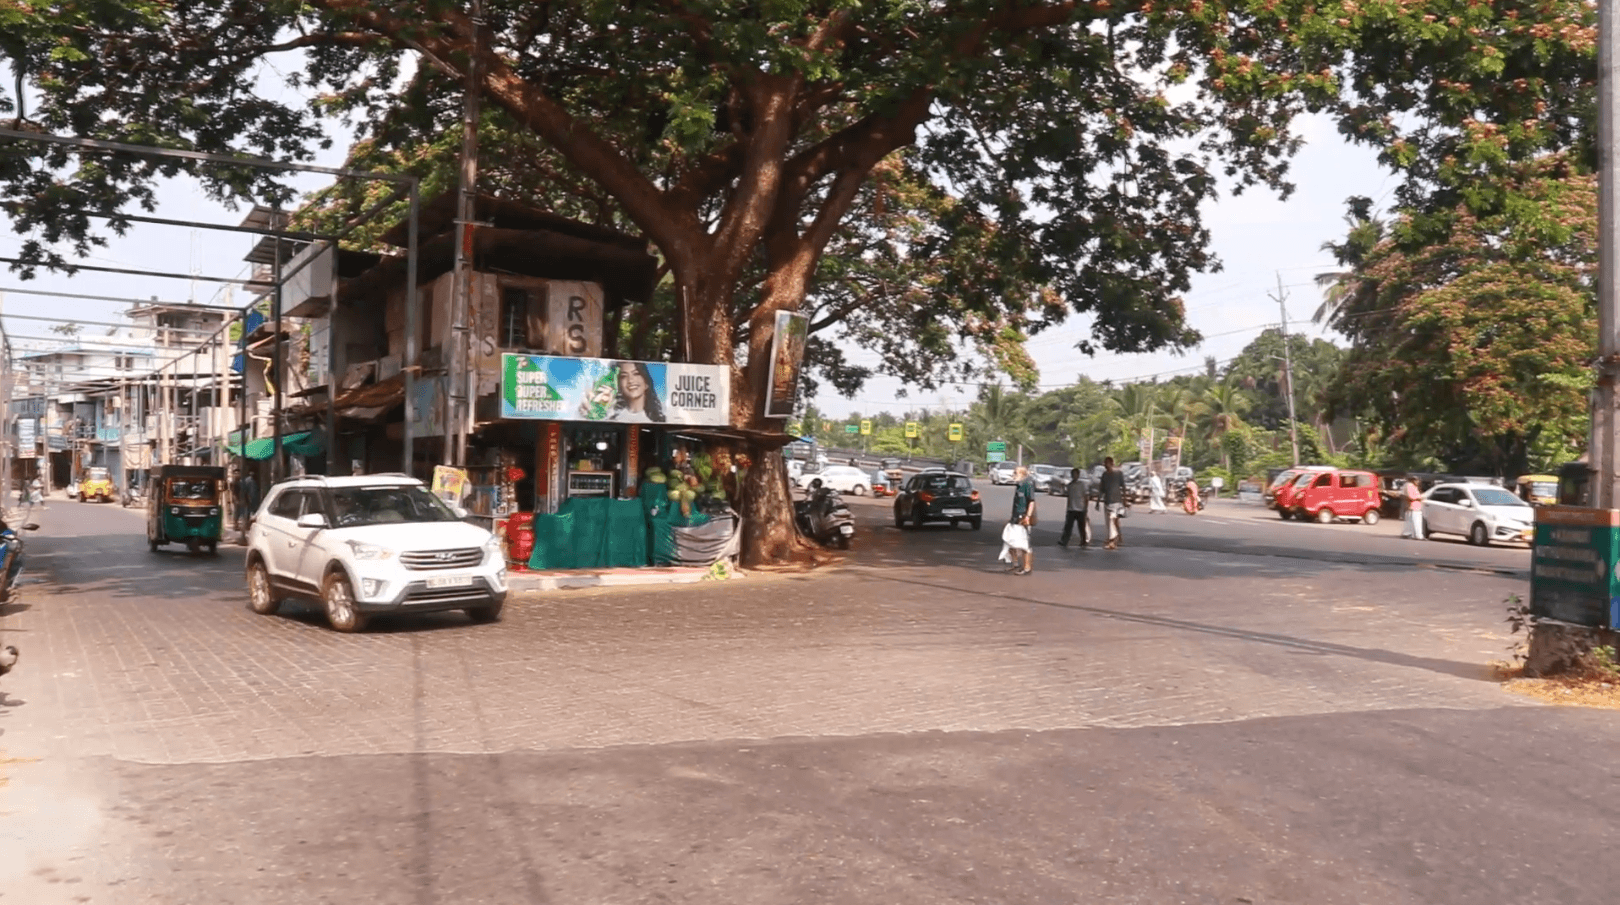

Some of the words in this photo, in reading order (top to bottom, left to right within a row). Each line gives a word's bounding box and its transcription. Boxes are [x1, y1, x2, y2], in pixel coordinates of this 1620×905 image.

[516, 371, 547, 384] SUPER
[674, 375, 711, 392] JUICE
[516, 399, 567, 413] REFRESHE
[671, 392, 716, 408] CORNER
